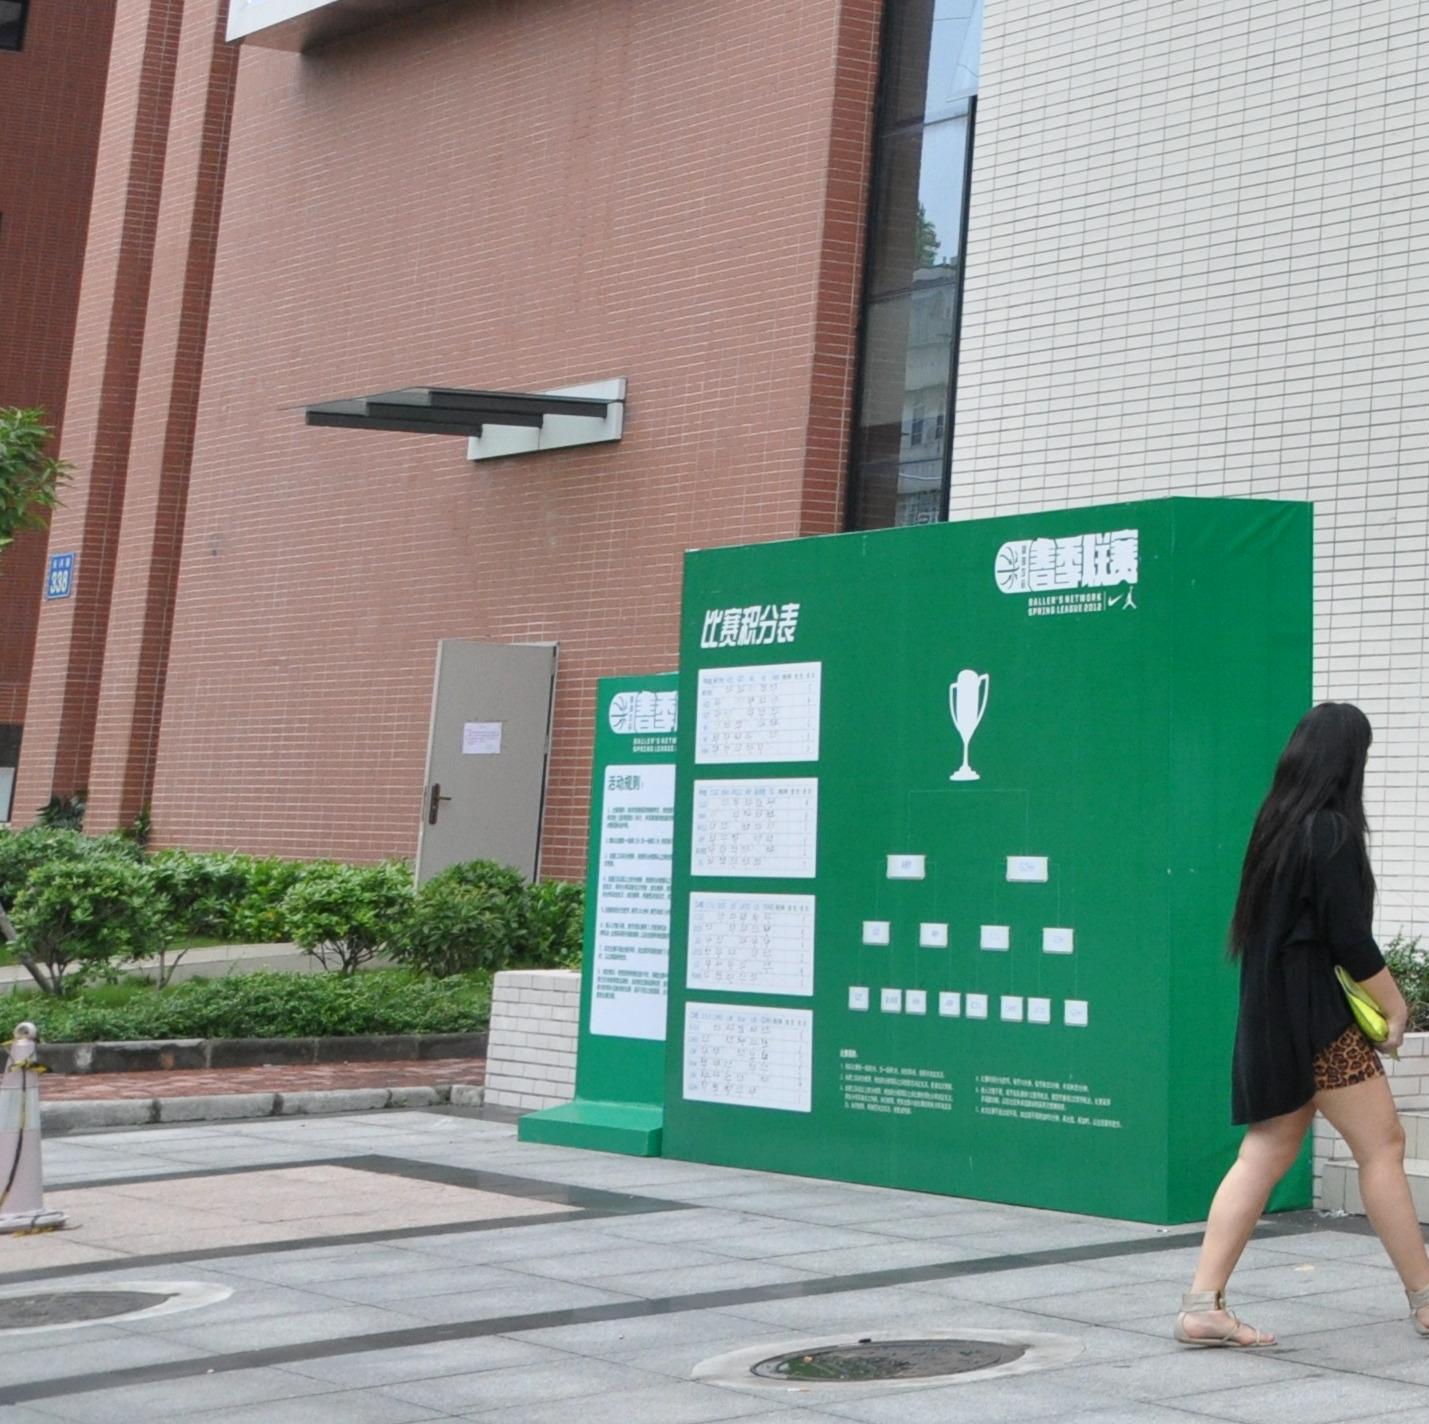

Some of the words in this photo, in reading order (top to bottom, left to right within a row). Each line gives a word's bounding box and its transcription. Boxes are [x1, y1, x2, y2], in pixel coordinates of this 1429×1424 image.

[1028, 594, 1063, 607] BALLER'S
[1064, 592, 1102, 604] NETWORK
[1028, 605, 1055, 617] SPRING
[1056, 603, 1083, 614] LEAGUE
[701, 603, 800, 648] 比赛积分表
